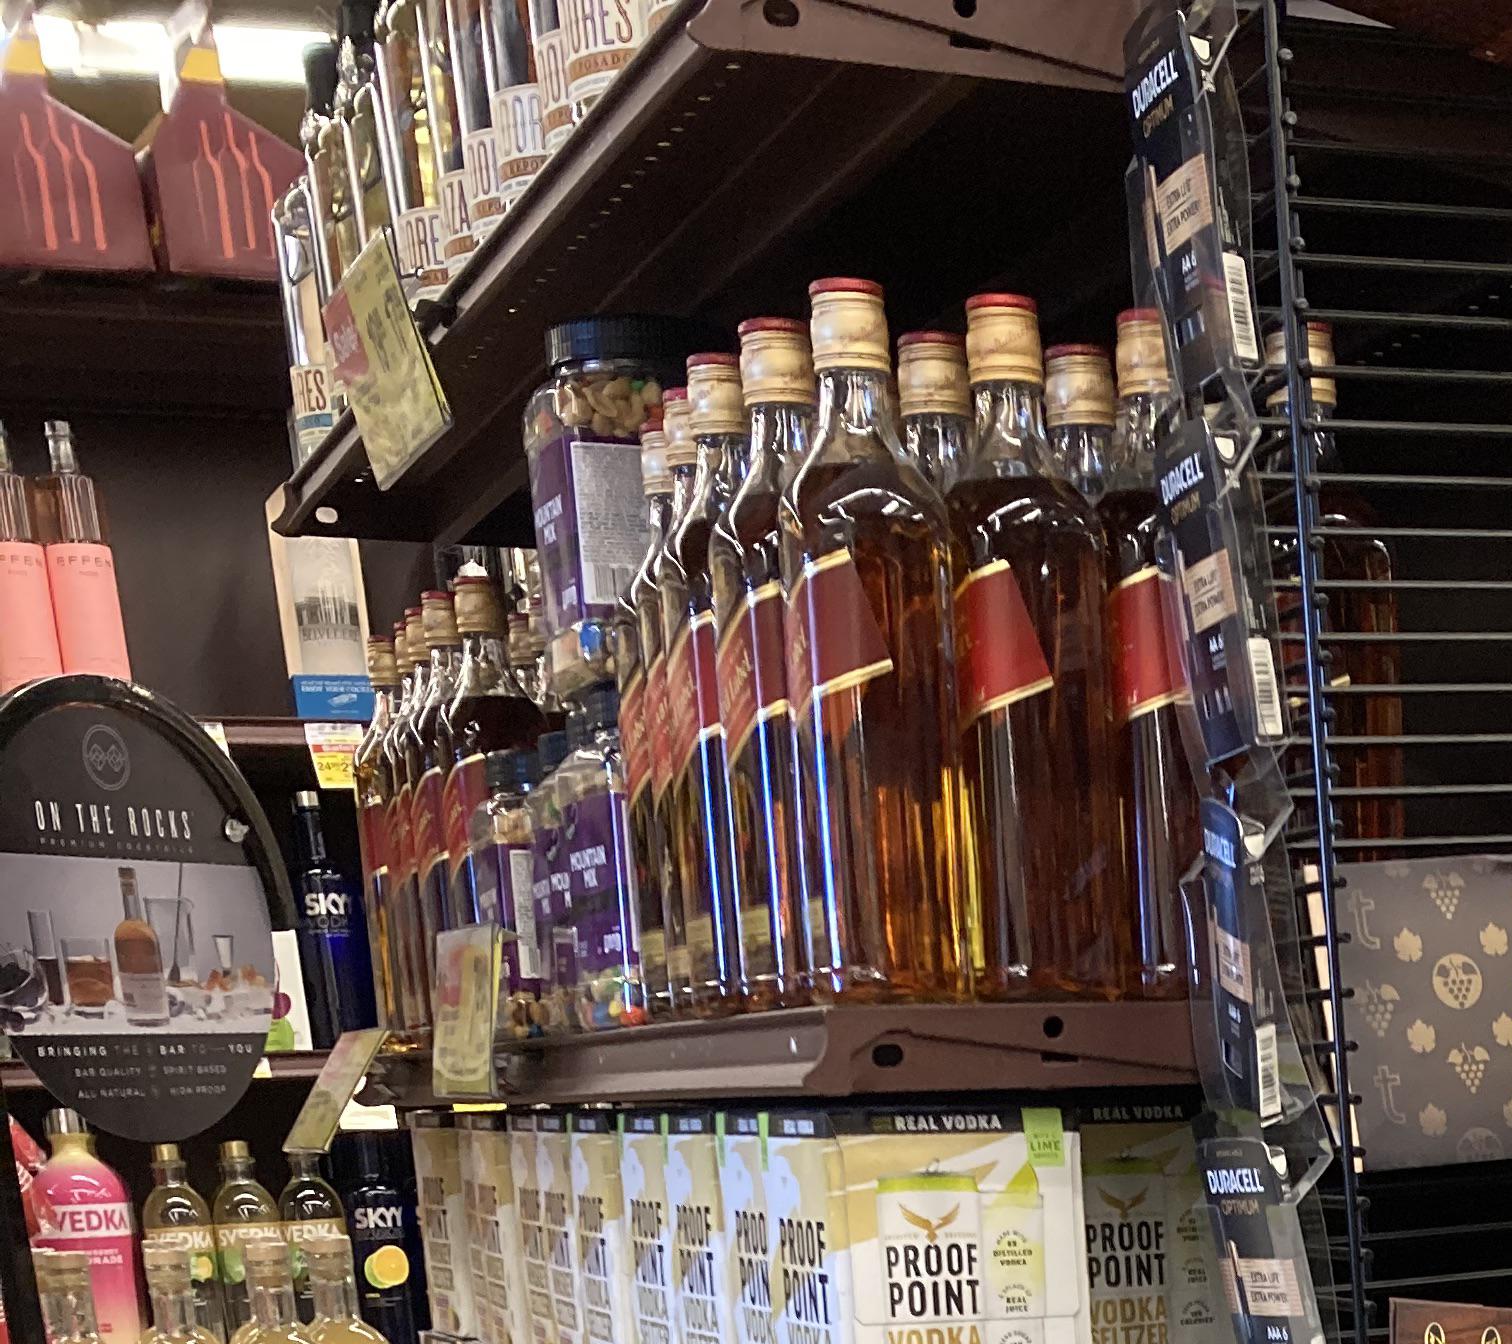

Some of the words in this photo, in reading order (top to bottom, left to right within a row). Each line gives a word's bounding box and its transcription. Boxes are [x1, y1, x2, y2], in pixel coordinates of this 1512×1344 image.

[1131, 51, 1179, 120] DURACELL
[1160, 452, 1204, 505] DURACELL
[34, 800, 61, 831] ON
[75, 803, 114, 835] THE
[128, 807, 192, 840] ROCKS
[37, 1044, 108, 1058] BRINGING
[159, 1045, 185, 1056] BAR
[895, 1117, 940, 1132] REAL
[942, 1115, 1001, 1131] VODKA
[1207, 1167, 1265, 1195] DURACELL
[354, 1206, 403, 1230] SKYY
[1221, 1200, 1260, 1217] OPTIMUM
[779, 1216, 827, 1271] PROOF
[886, 1243, 979, 1279] PROOF
[782, 1263, 831, 1325] POINT
[889, 1279, 980, 1318] POINT
